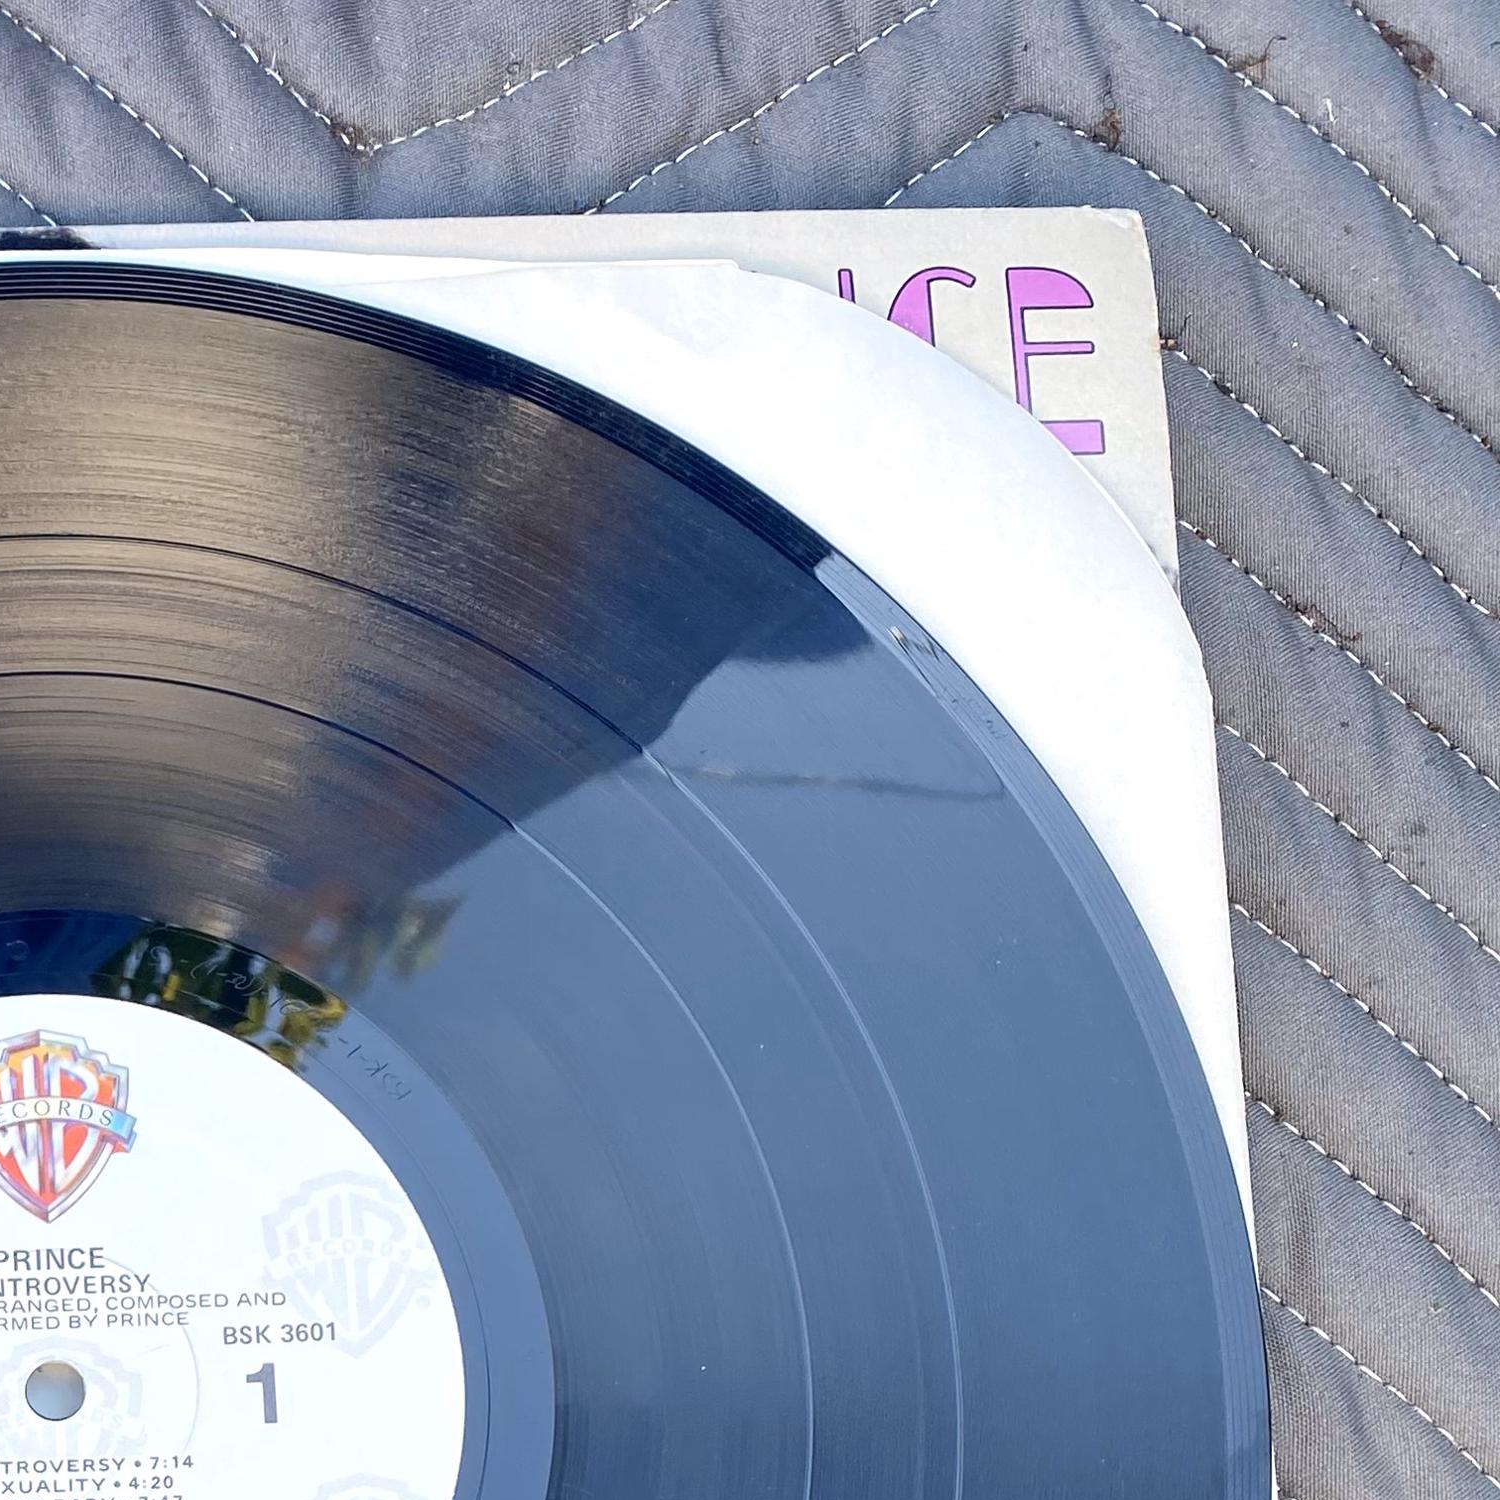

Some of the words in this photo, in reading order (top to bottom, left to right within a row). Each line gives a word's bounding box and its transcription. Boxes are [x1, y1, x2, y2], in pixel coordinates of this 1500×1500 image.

[105, 1293, 229, 1311] COMPOSED
[236, 1292, 286, 1307] AND
[68, 1314, 98, 1329] BY
[106, 1311, 189, 1328] PRINCE
[223, 1324, 272, 1345] BSK
[280, 1321, 336, 1343] 3601
[246, 1362, 278, 1424] 1
[149, 1454, 194, 1470] 7:14
[128, 1475, 174, 1490] 4:20
